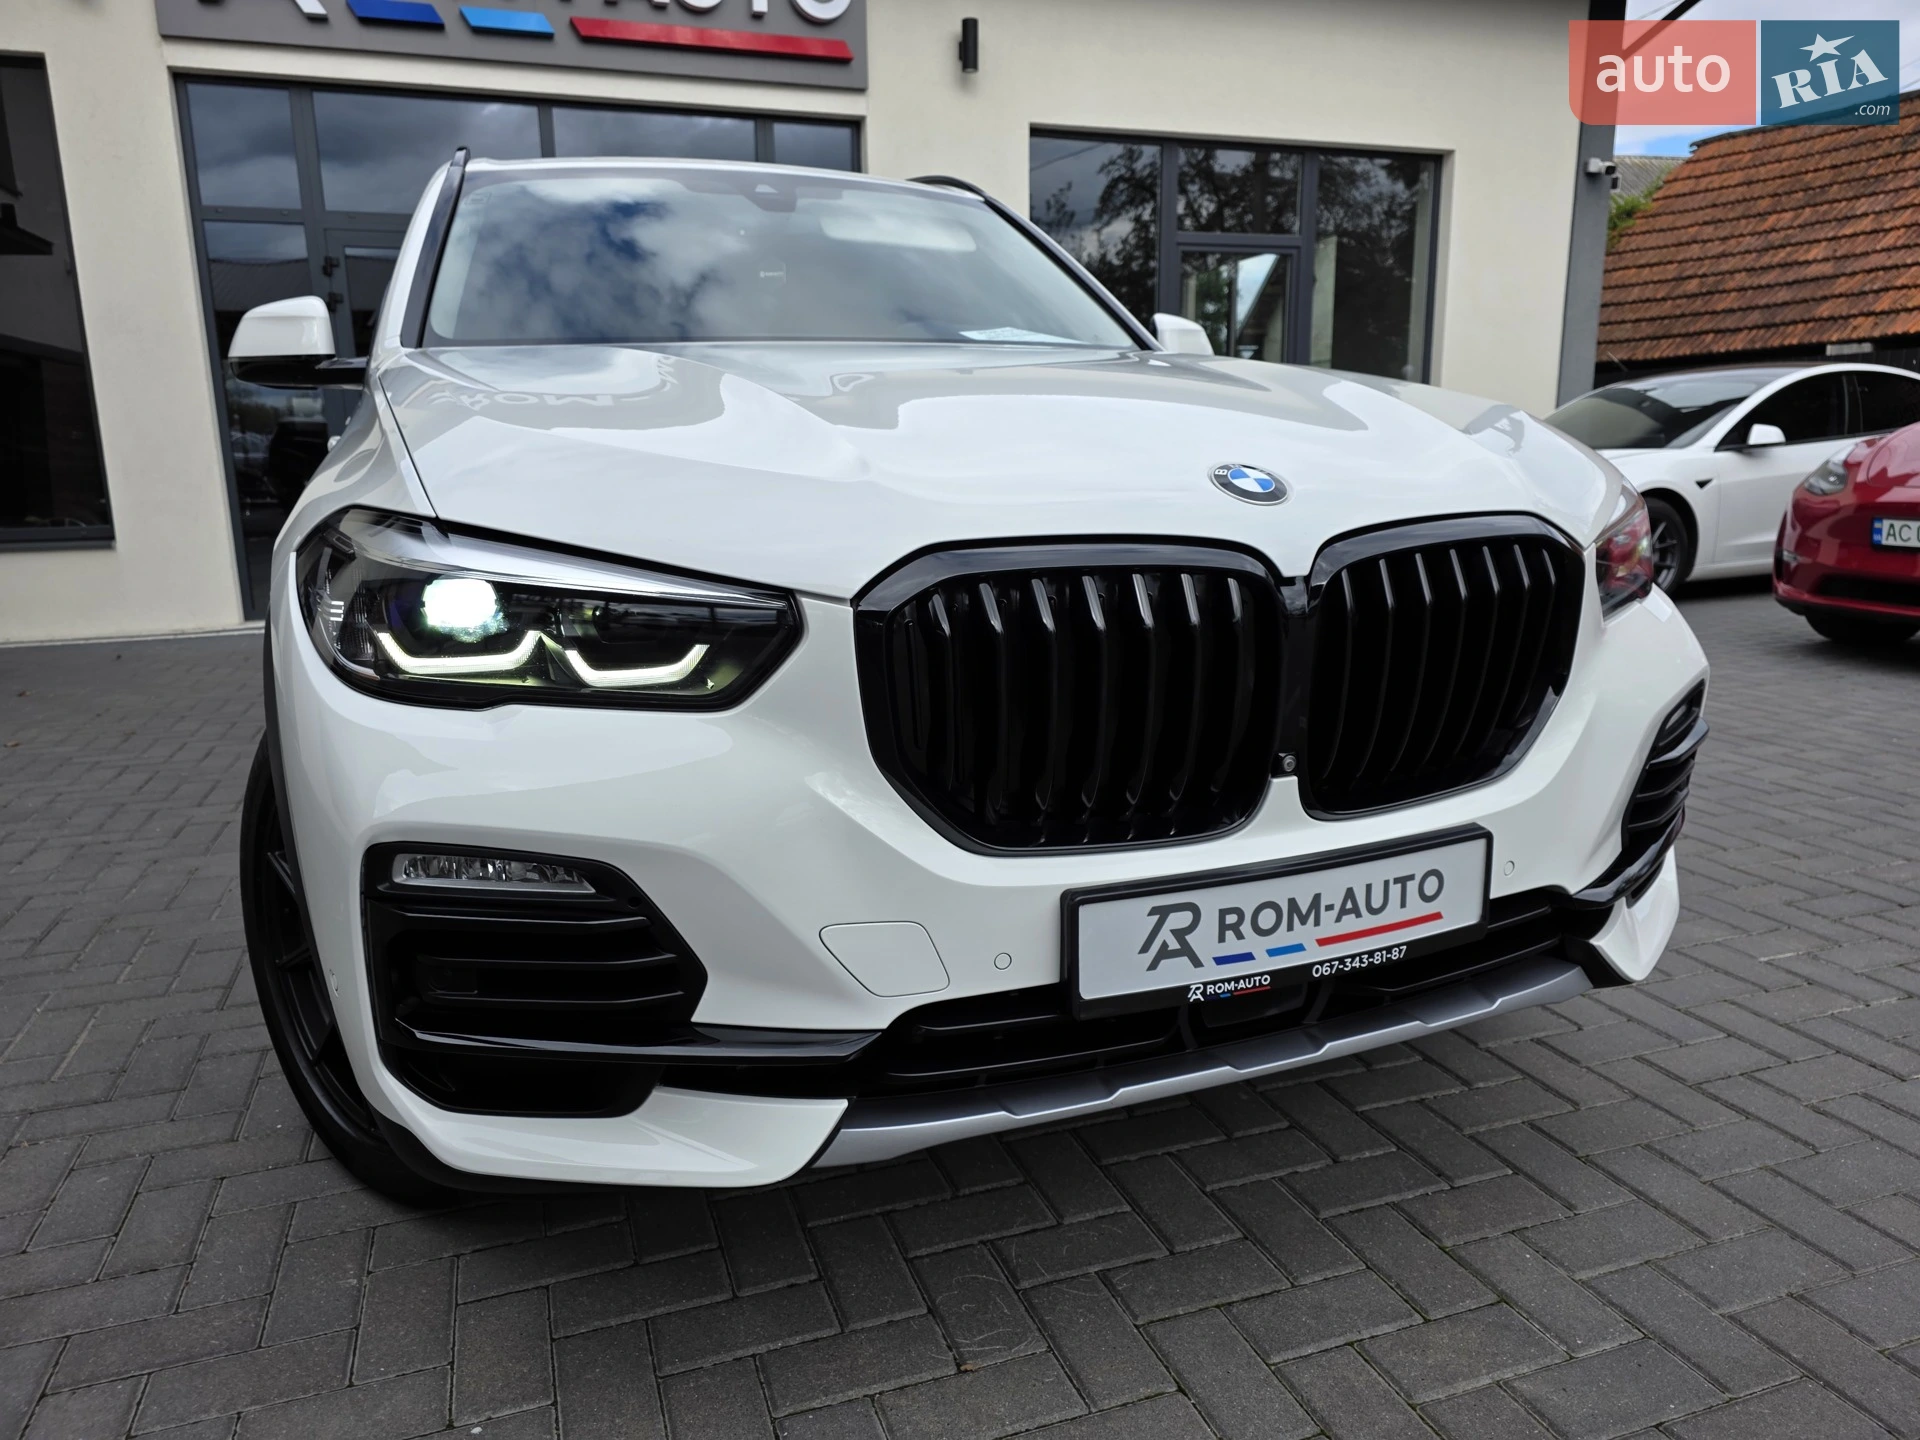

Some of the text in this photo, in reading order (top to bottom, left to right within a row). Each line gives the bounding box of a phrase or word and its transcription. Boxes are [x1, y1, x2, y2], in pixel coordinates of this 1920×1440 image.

[1217, 868, 1445, 944] ROM-AUTO
[1312, 946, 1407, 978] 067-343-81-87
[1206, 975, 1271, 995] ROM-AUTO
